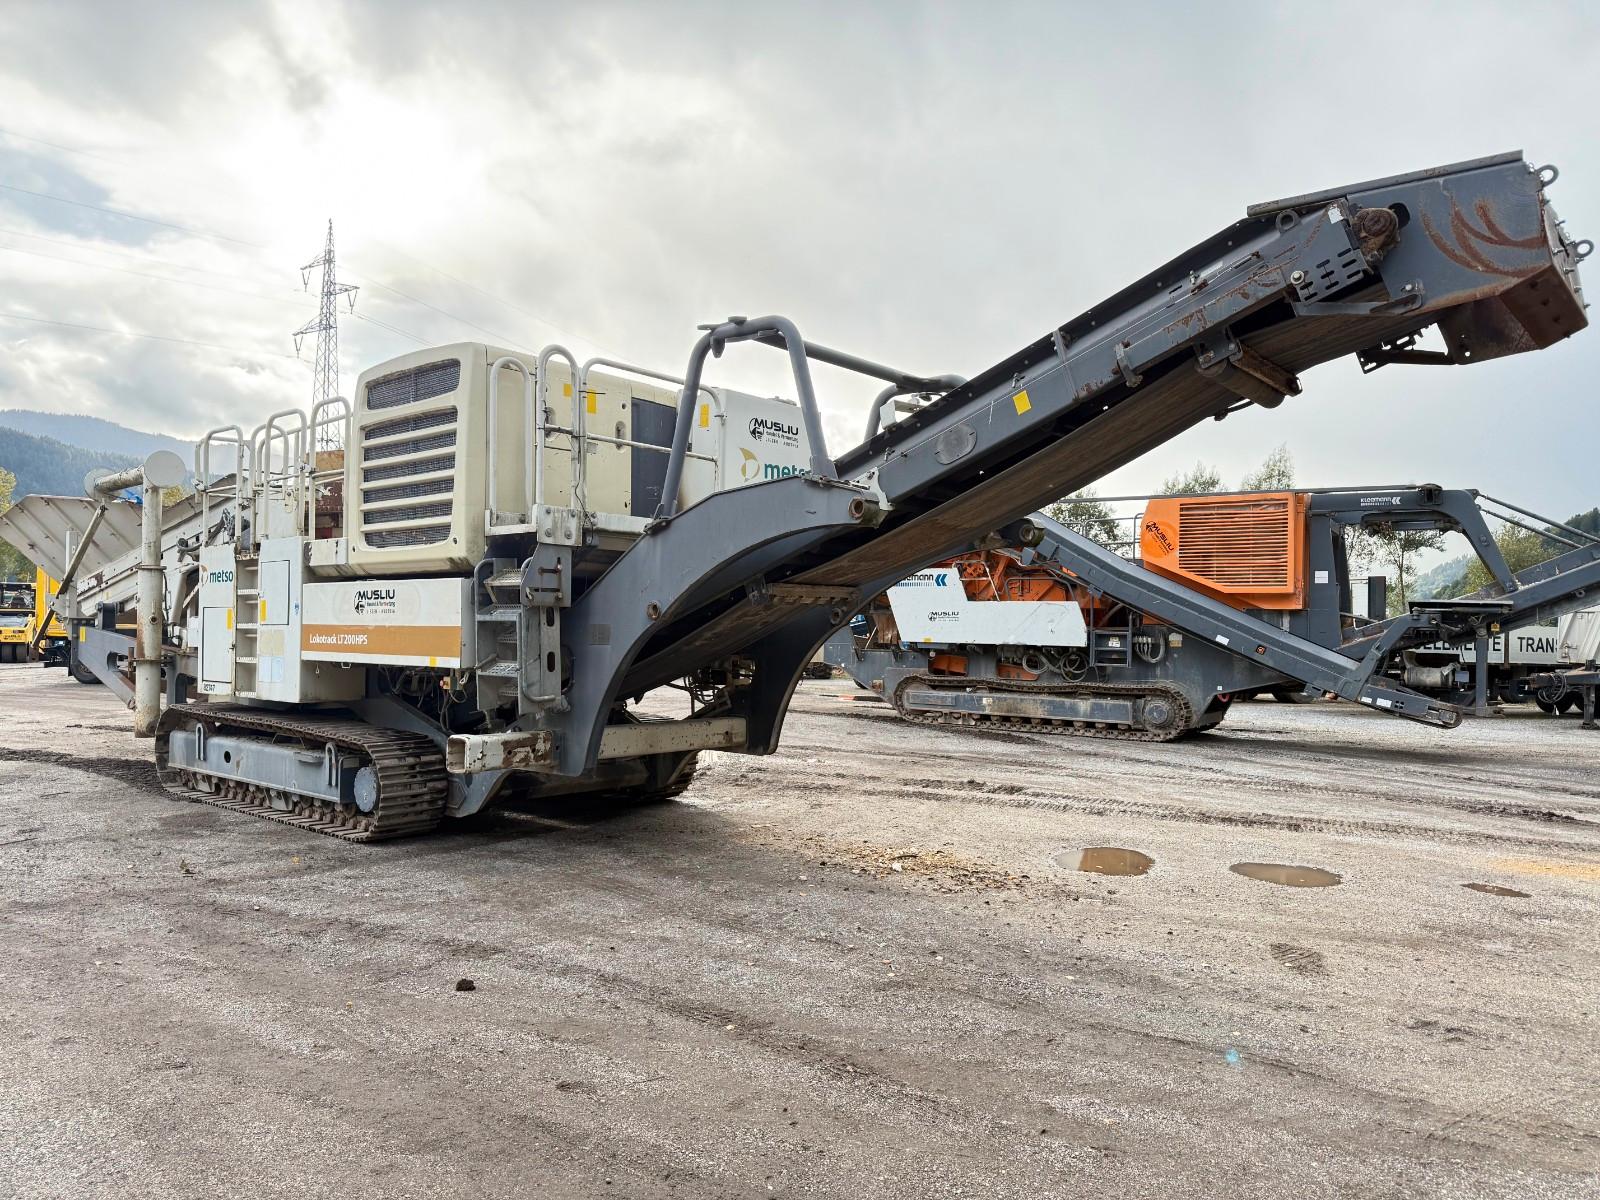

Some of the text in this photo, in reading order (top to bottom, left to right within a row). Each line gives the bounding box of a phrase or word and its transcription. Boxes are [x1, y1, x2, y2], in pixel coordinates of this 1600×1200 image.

[754, 417, 799, 436] MUSLIU
[764, 463, 811, 480] met
[209, 569, 234, 583] metso
[358, 589, 396, 600] MUSLIU
[309, 633, 368, 645] Lokotrack LT200HPS
